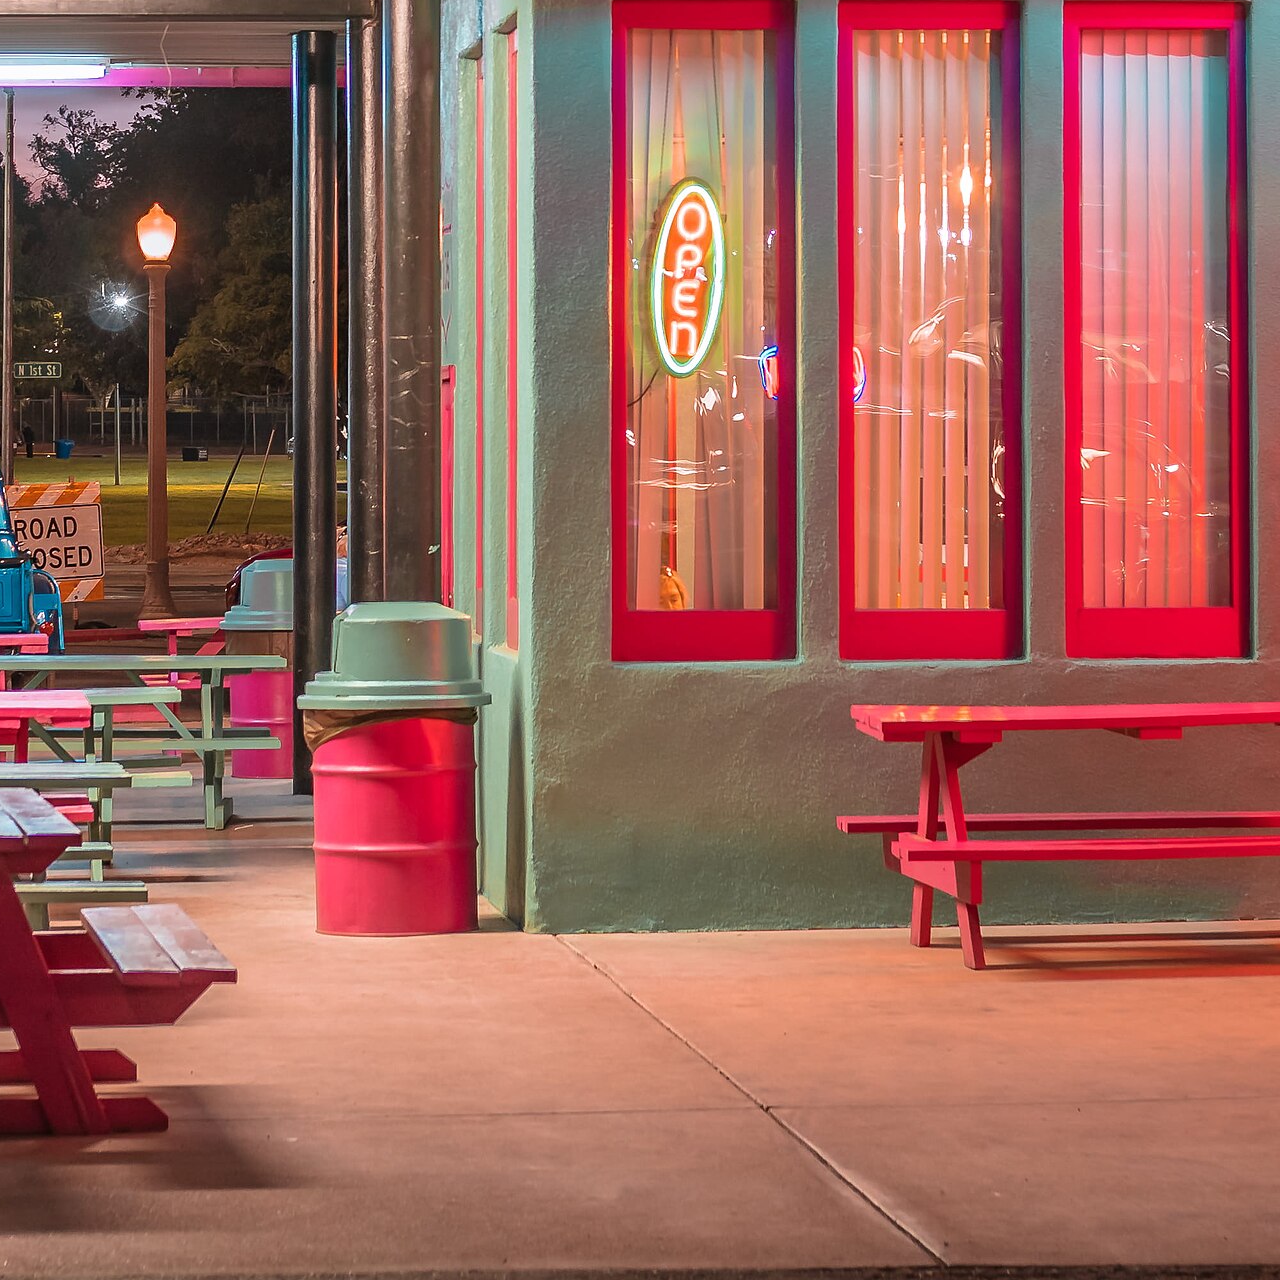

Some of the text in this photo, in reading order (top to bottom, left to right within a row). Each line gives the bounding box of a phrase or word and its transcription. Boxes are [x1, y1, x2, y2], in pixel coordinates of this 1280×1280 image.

[18, 364, 56, 376] N 1st St
[14, 516, 78, 540] ROAD
[32, 545, 92, 570] OSED
